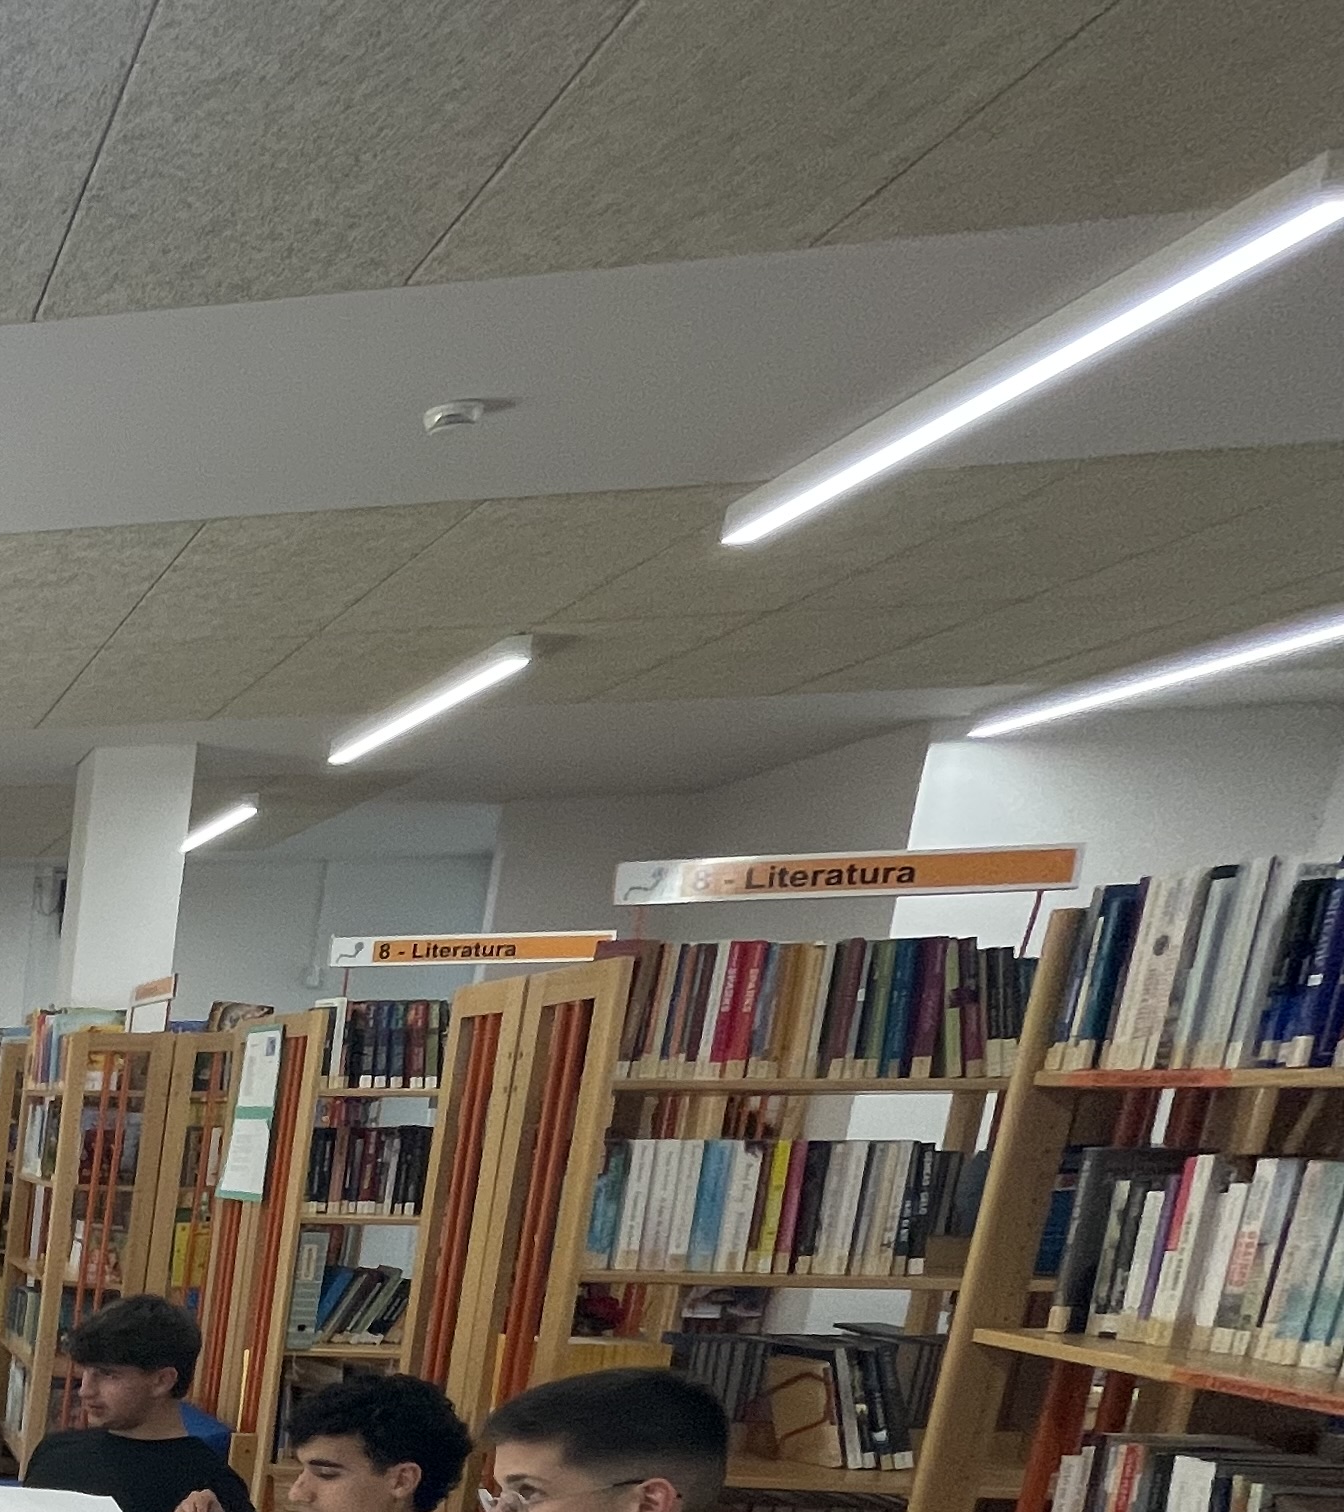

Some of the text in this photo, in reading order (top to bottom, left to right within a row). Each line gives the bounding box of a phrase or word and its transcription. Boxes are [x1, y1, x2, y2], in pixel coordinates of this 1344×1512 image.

[692, 869, 711, 891] 8
[744, 864, 917, 890] Literatura
[378, 943, 391, 960] 8
[411, 942, 517, 959] Literatura
